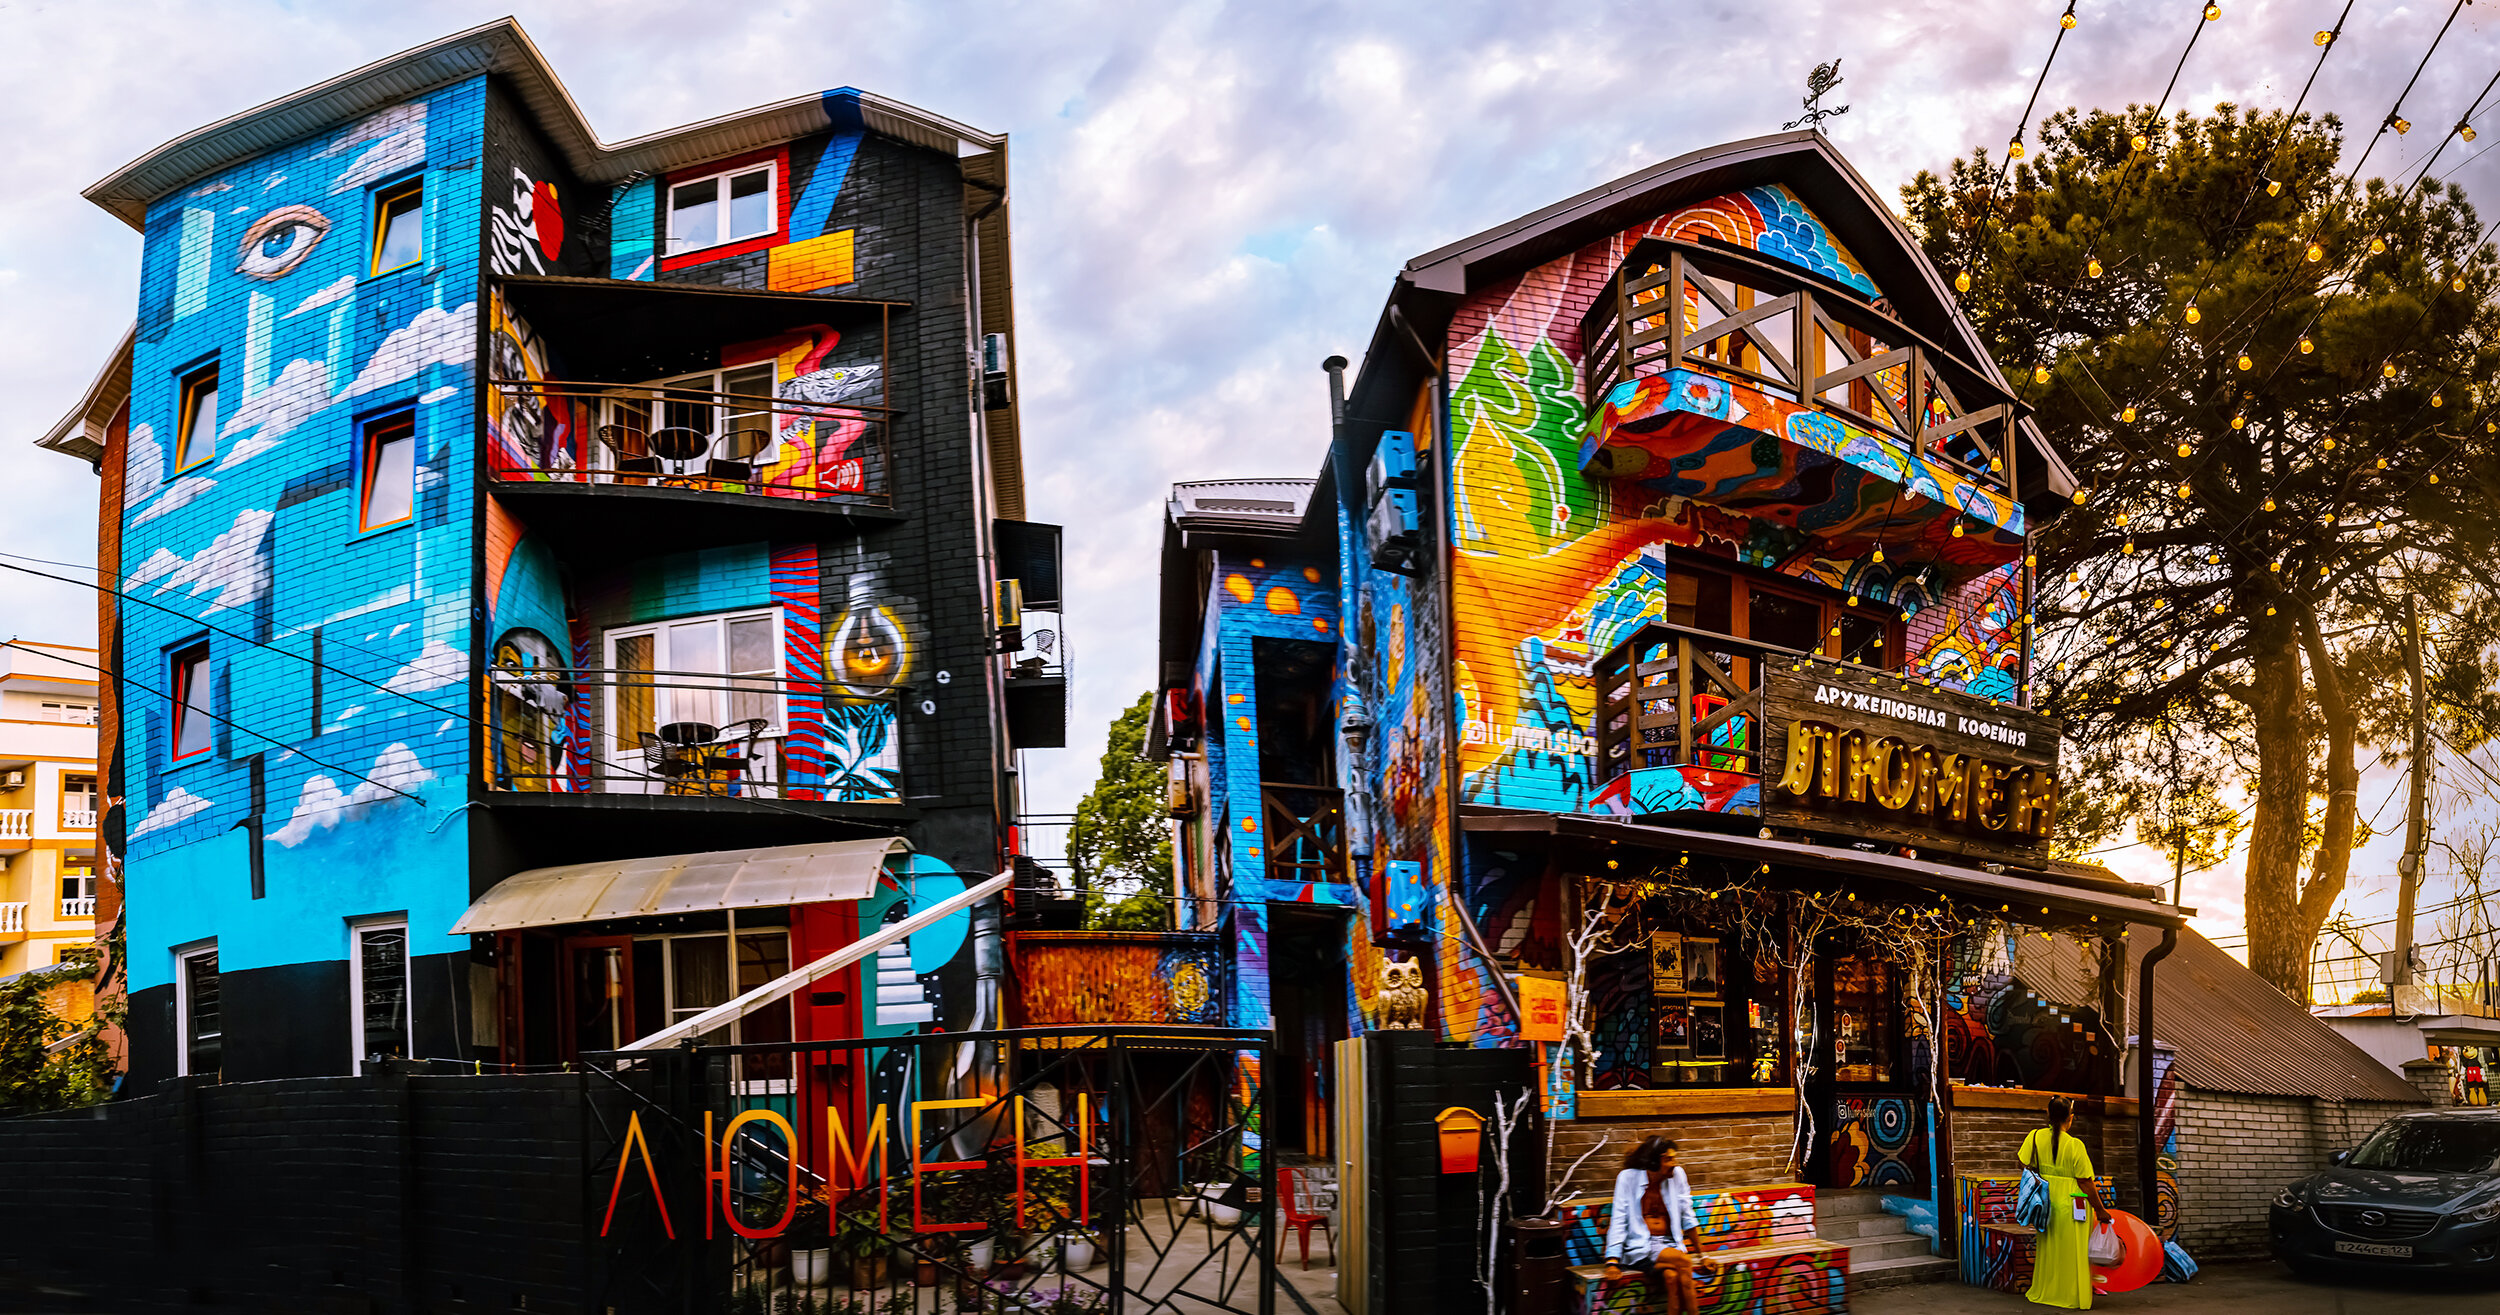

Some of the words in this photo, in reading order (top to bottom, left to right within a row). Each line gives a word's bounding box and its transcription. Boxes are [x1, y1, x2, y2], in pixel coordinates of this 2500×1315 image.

[1814, 684, 1947, 728] ДРУЖЕЛЮБНАЯ
[1958, 717, 2027, 748] КОФЕЙНЯ
[1777, 719, 2059, 838] ЛЮМЕН
[600, 1093, 1089, 1241] ЛЮМЕН
